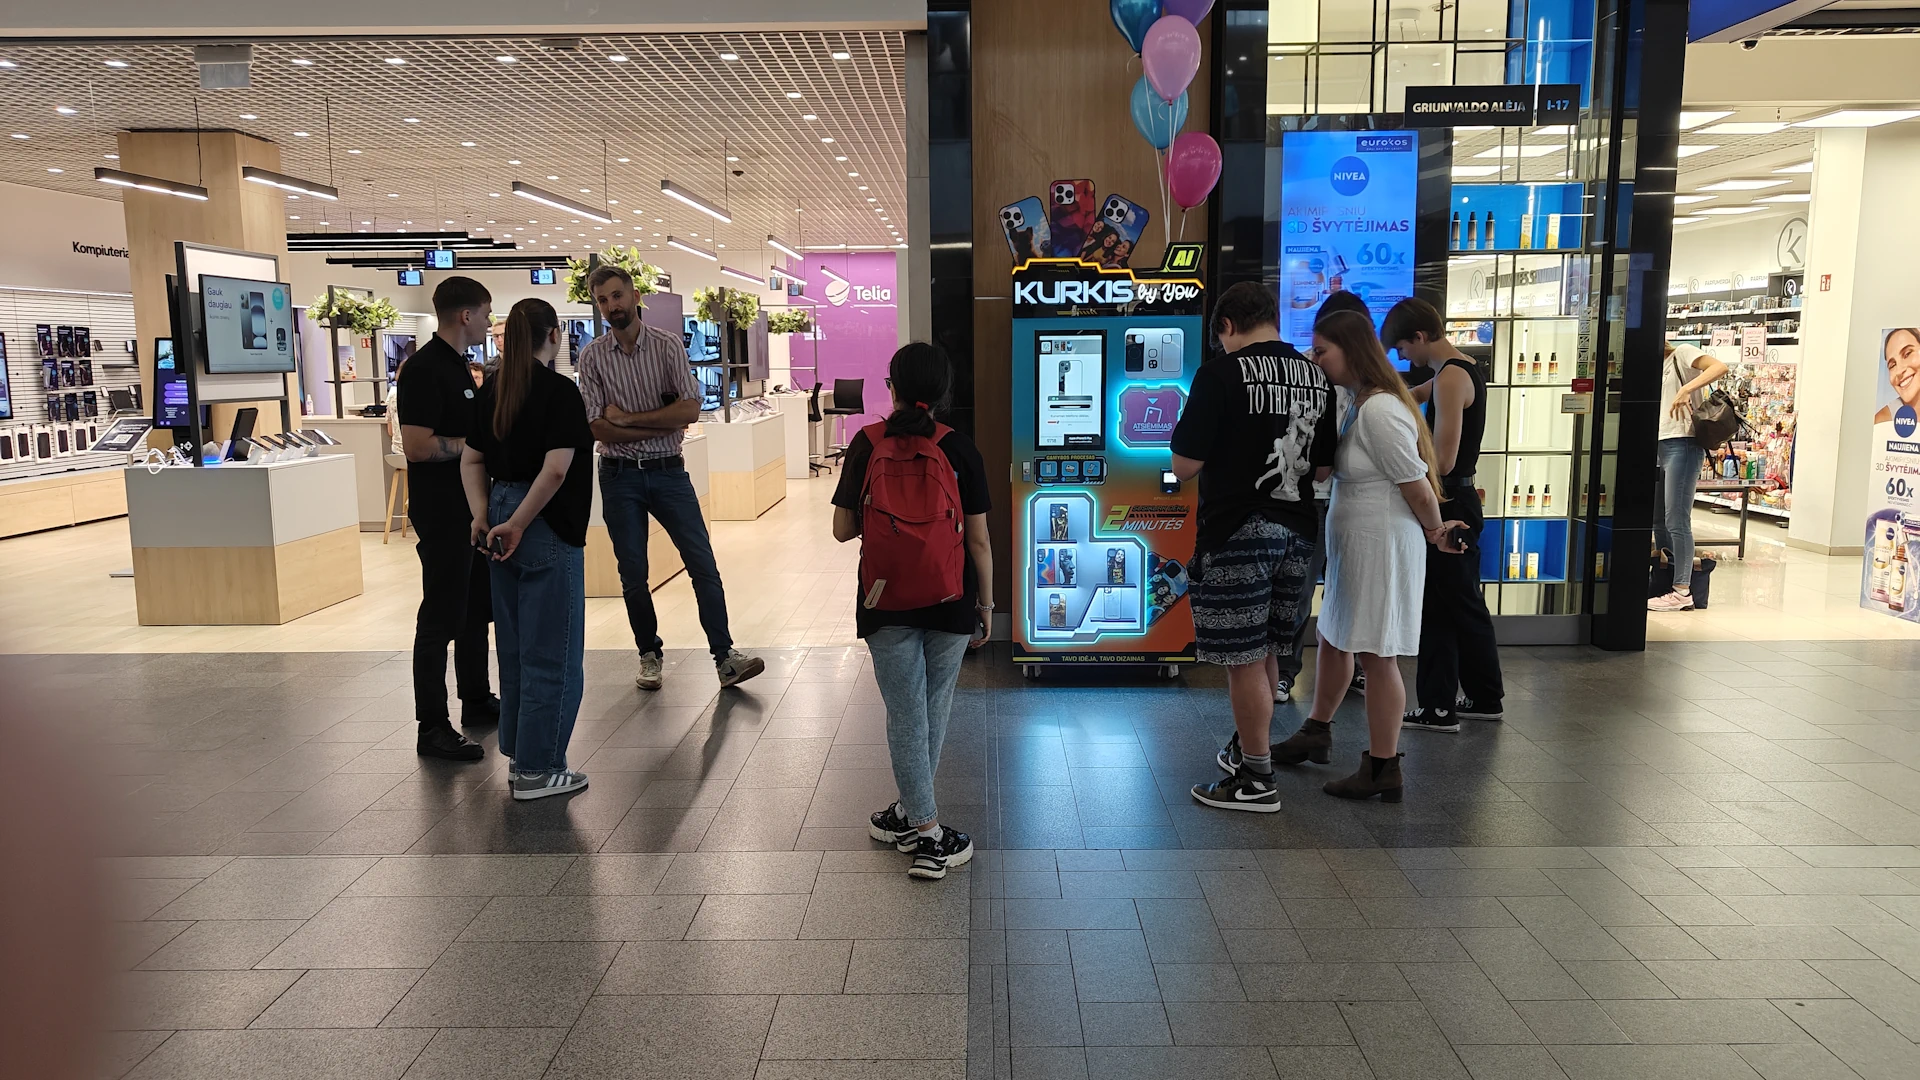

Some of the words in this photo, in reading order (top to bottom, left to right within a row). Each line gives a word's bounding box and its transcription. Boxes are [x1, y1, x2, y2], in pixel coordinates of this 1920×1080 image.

[1412, 102, 1490, 113] GRIUNVALDO
[1491, 99, 1526, 113] ALĖJA
[1546, 99, 1570, 111] I-17
[1361, 138, 1408, 147] eurokos
[1334, 172, 1366, 181] NIVEA
[1287, 221, 1308, 234] 3D
[1312, 217, 1410, 233] ŠVYTĖJIMAS
[1172, 250, 1196, 267] AI
[1356, 242, 1406, 265] 60x
[207, 287, 223, 296] Gauk
[853, 285, 891, 301] Telia
[1014, 280, 1134, 305] KURKIS
[1137, 284, 1158, 304] by
[1160, 283, 1200, 303] You
[208, 300, 232, 311] daugiau
[1237, 355, 1280, 383] ENJOY
[1280, 357, 1311, 387] YOUR
[1246, 384, 1265, 414] TO
[1267, 384, 1288, 415] THE
[1895, 417, 1915, 426] NIVEA
[1888, 442, 1920, 453] NAUJIENA
[1875, 462, 1885, 472] 3D
[1885, 462, 1920, 475] ŠVYTĖJIM
[1885, 477, 1914, 498] 60x
[1101, 505, 1131, 531] 2
